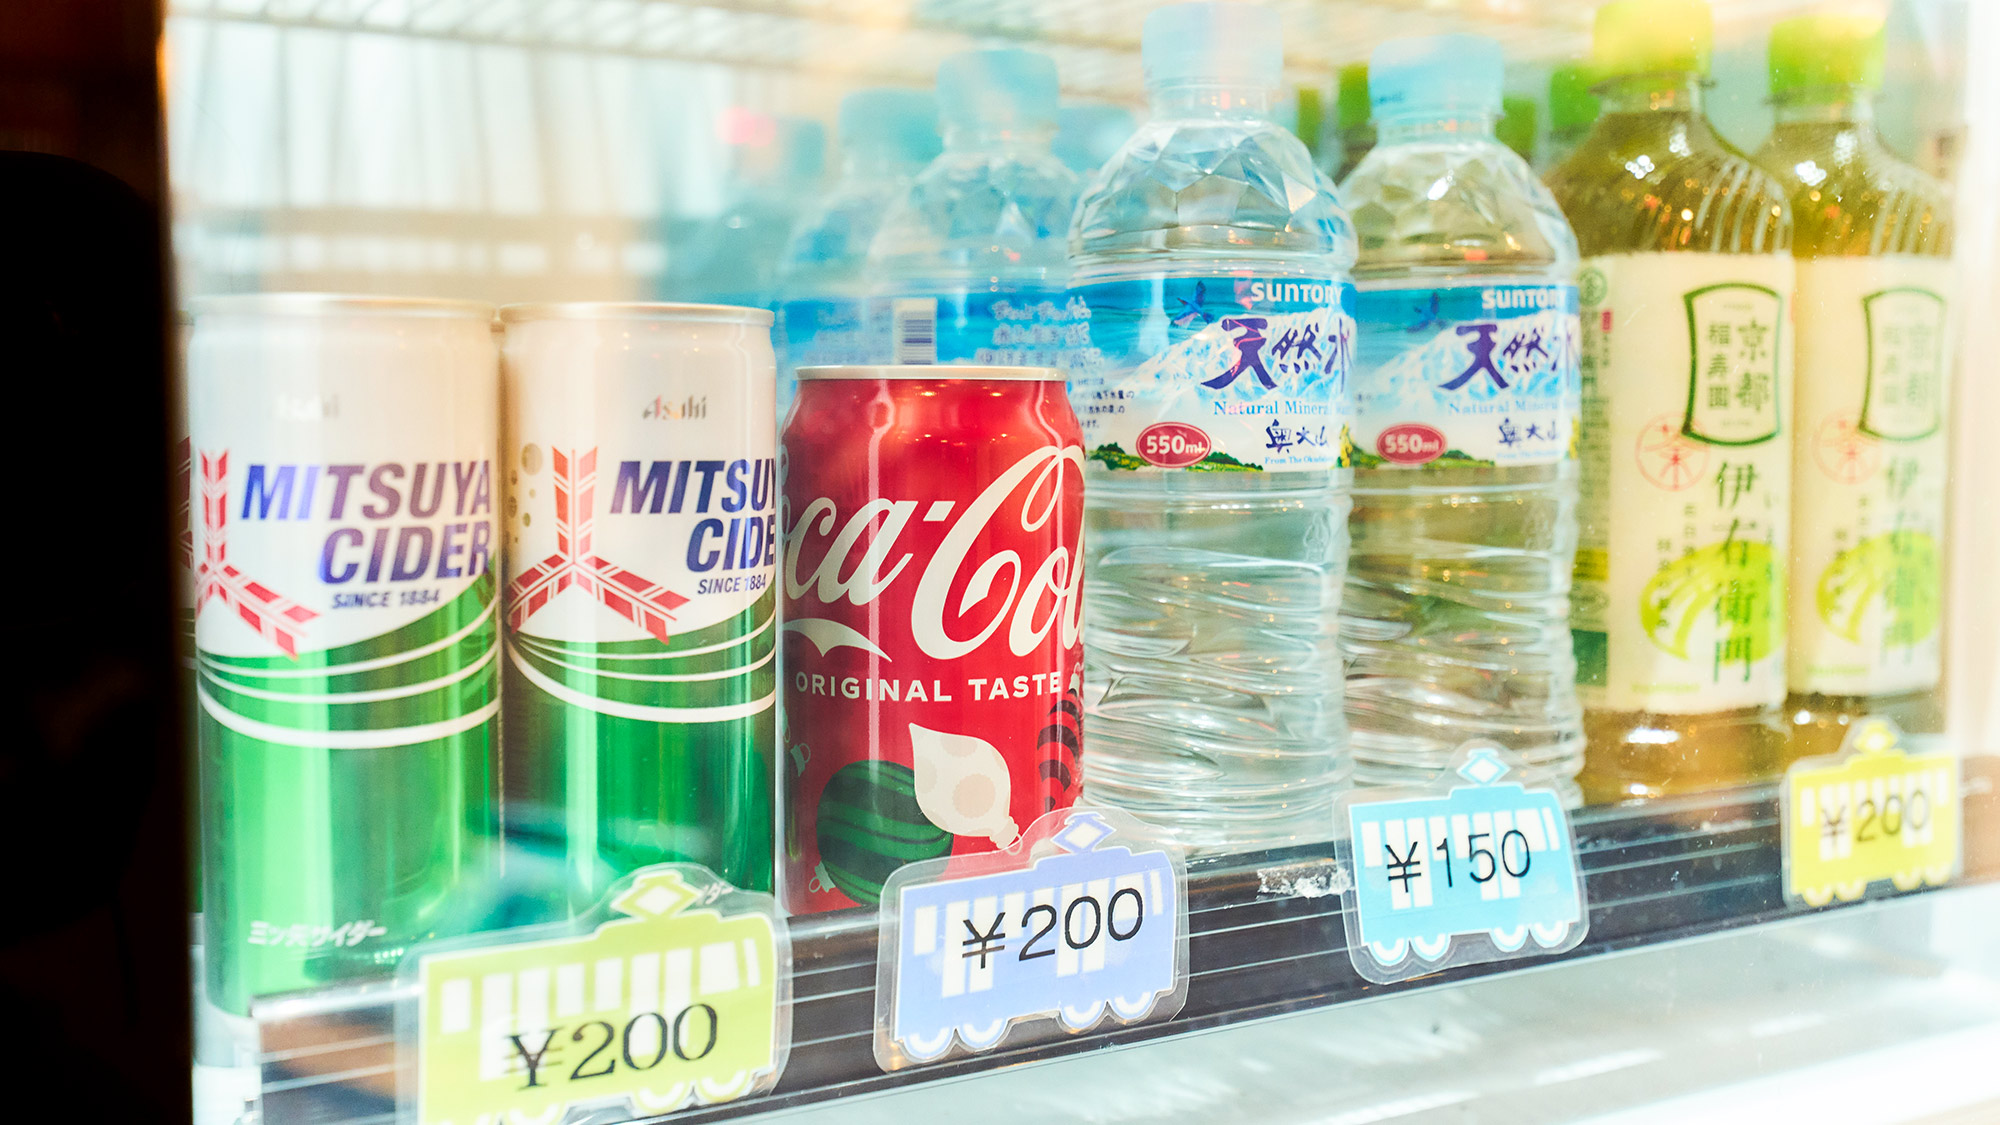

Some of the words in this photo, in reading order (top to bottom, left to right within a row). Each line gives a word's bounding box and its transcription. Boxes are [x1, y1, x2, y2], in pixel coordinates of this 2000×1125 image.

[642, 394, 707, 421] Asahi
[1214, 400, 1278, 416] Natural
[241, 460, 491, 521] MITSUYA
[317, 521, 491, 585] CIDER
[686, 513, 776, 573] CIDE
[331, 591, 389, 609] SINCE
[399, 589, 440, 607] 1884
[697, 577, 741, 595] SINCE
[744, 573, 767, 591] 1884
[796, 671, 952, 702] ORIGINAL
[968, 671, 1062, 701] TASTE
[1821, 789, 1931, 847] ¥200
[1385, 829, 1531, 893] ¥150
[962, 887, 1144, 970] ¥200
[503, 1003, 718, 1092] ¥200
